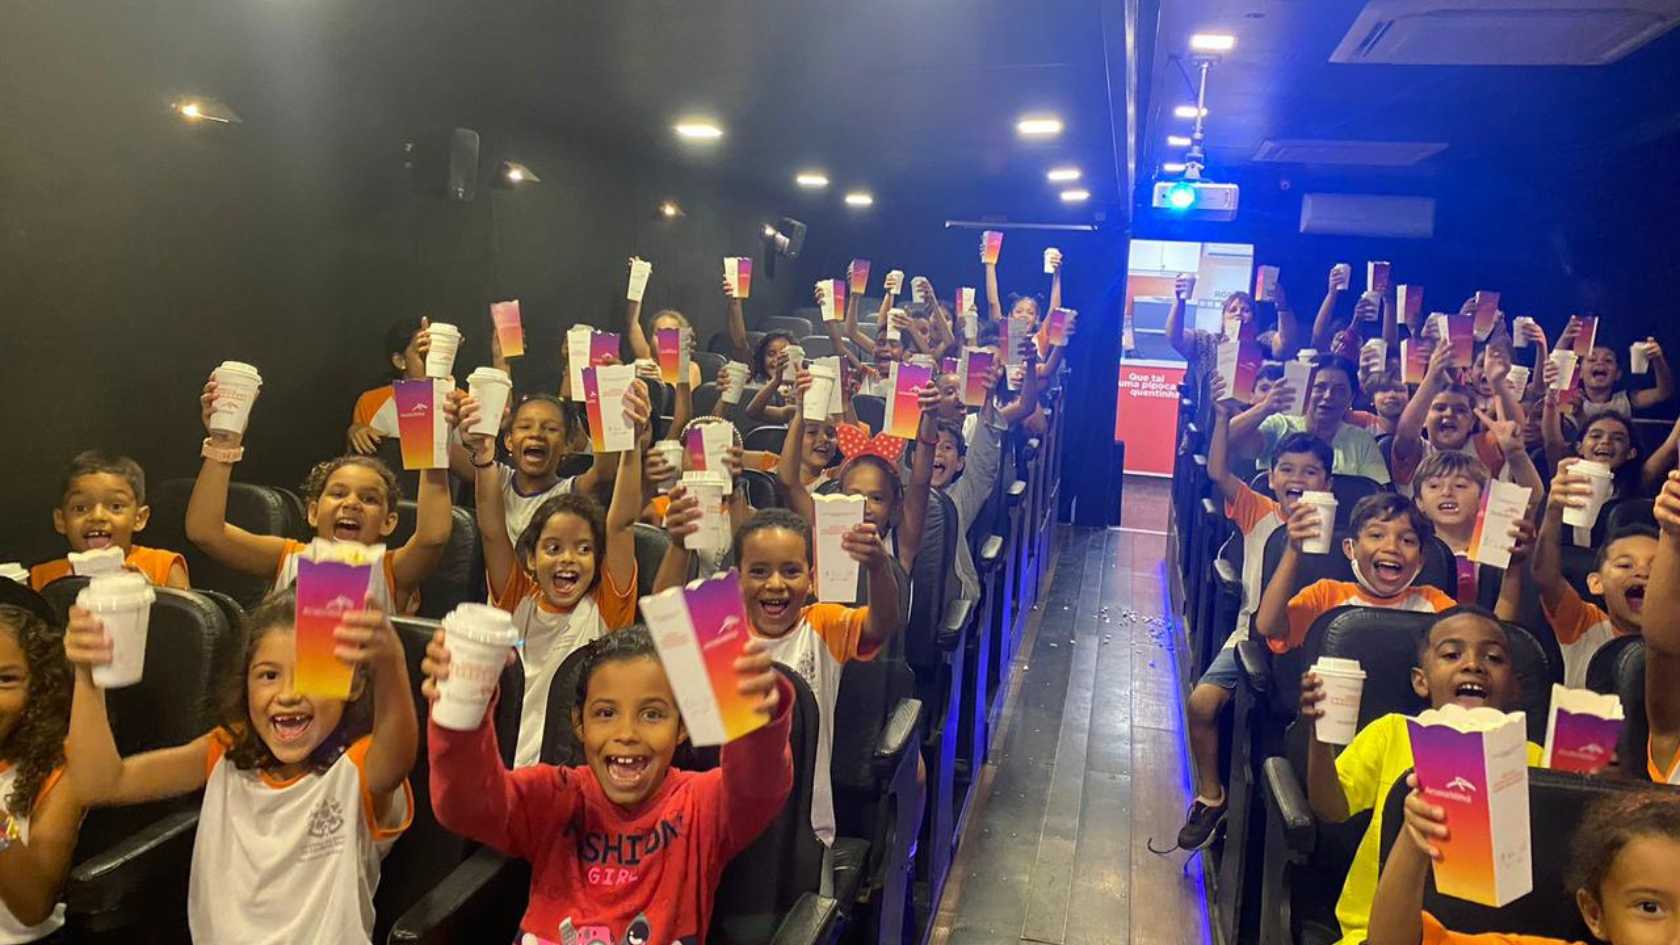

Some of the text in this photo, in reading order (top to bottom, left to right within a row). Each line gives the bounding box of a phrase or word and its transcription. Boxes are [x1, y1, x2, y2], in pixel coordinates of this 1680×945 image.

[1129, 372, 1165, 383] Que tal
[1142, 382, 1177, 392] pipoca
